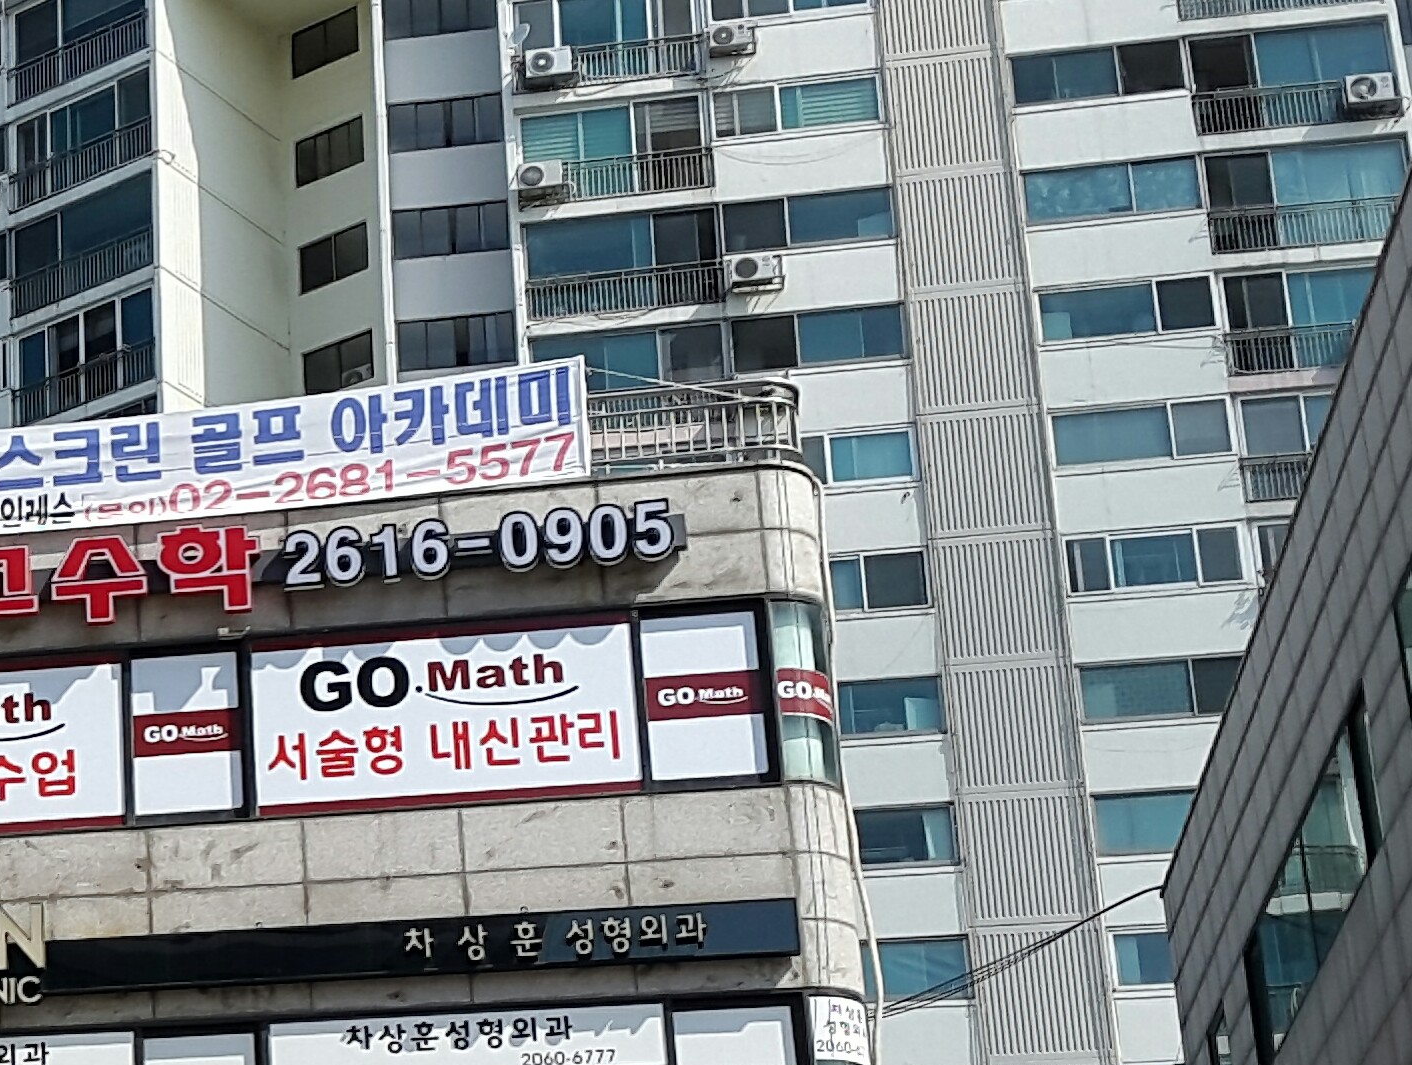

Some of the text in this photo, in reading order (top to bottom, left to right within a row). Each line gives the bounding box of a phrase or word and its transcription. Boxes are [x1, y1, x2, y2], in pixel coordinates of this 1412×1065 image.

[191, 405, 305, 475] 골프
[330, 365, 573, 456] 아카데미
[169, 432, 575, 514] 02-2681-5577
[284, 500, 678, 590] 2616-0905
[267, 710, 622, 781] 서술형 내신관리
[565, 912, 707, 956] 성형외과
